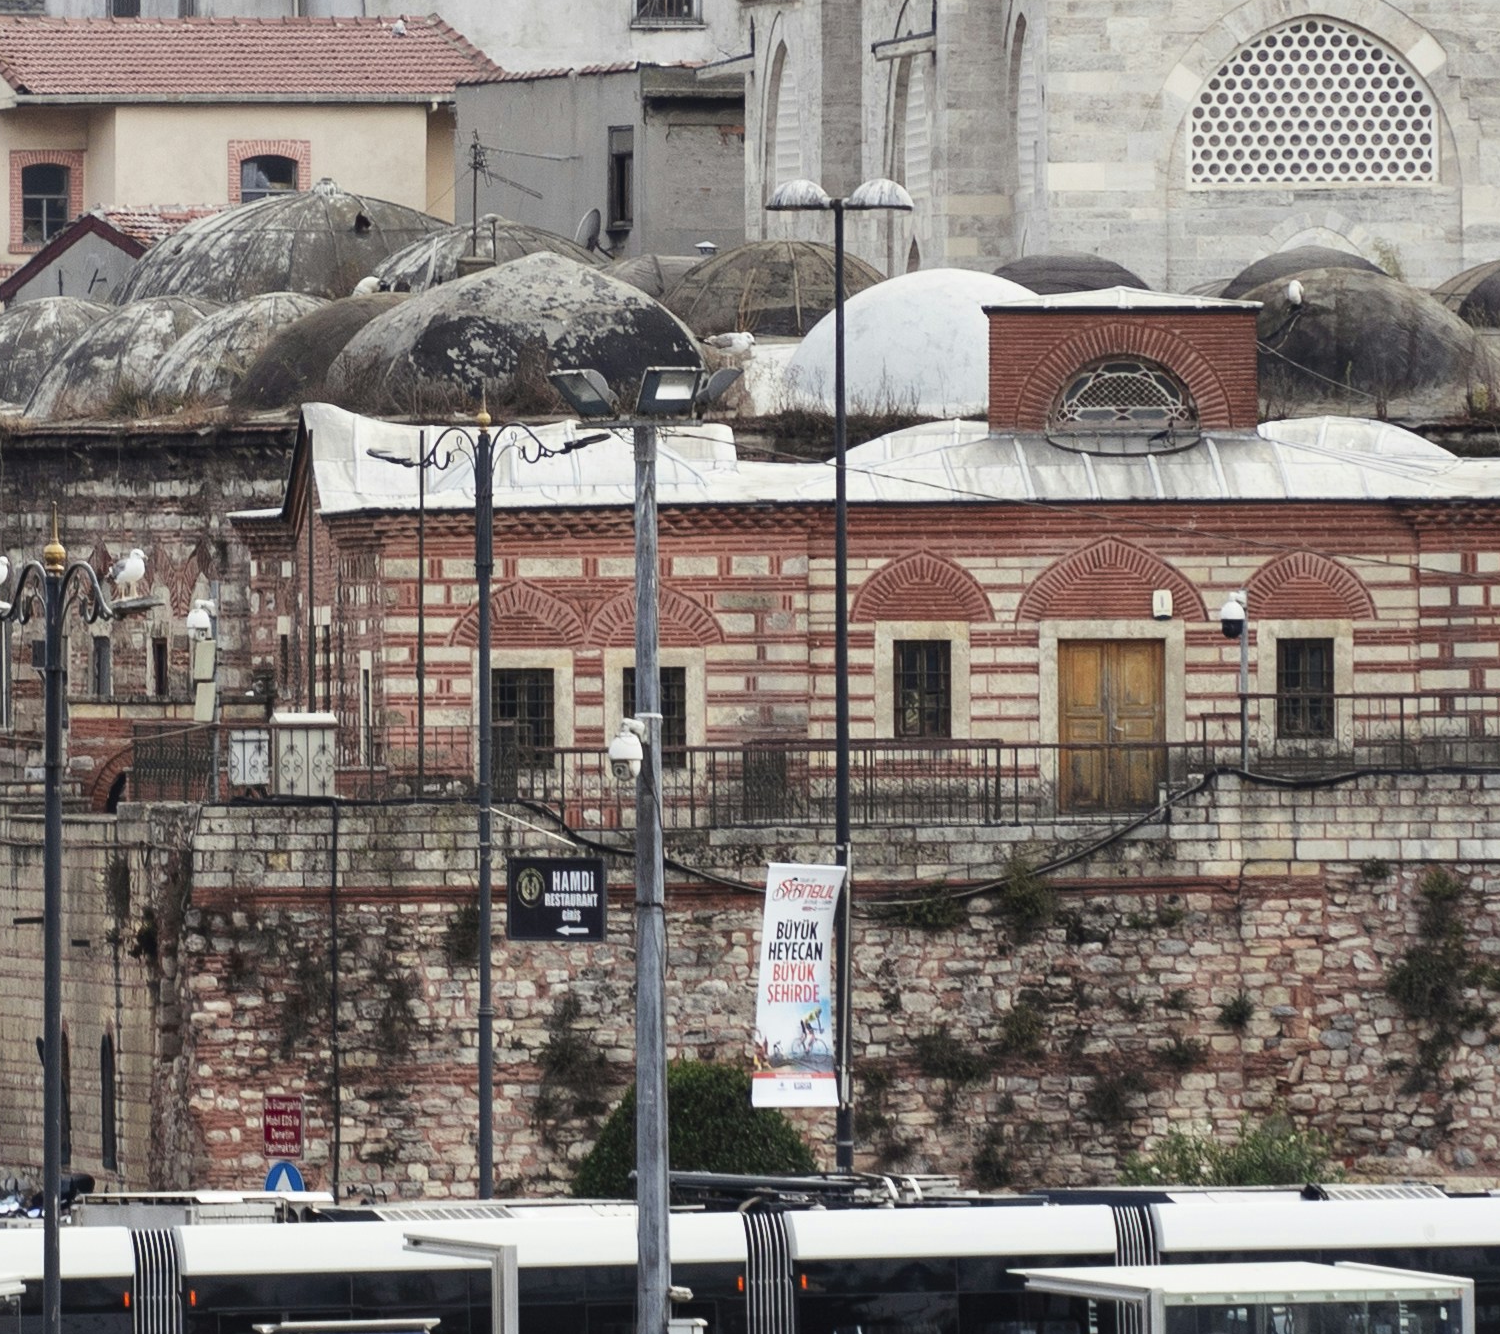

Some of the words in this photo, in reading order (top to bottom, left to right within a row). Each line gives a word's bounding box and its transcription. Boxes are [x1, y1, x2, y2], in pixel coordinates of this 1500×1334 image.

[544, 893, 598, 907] RESTAURANT
[776, 919, 819, 941] BÜYÜK
[768, 942, 823, 961] HEYECAN
[773, 961, 816, 982] BÜYÜK
